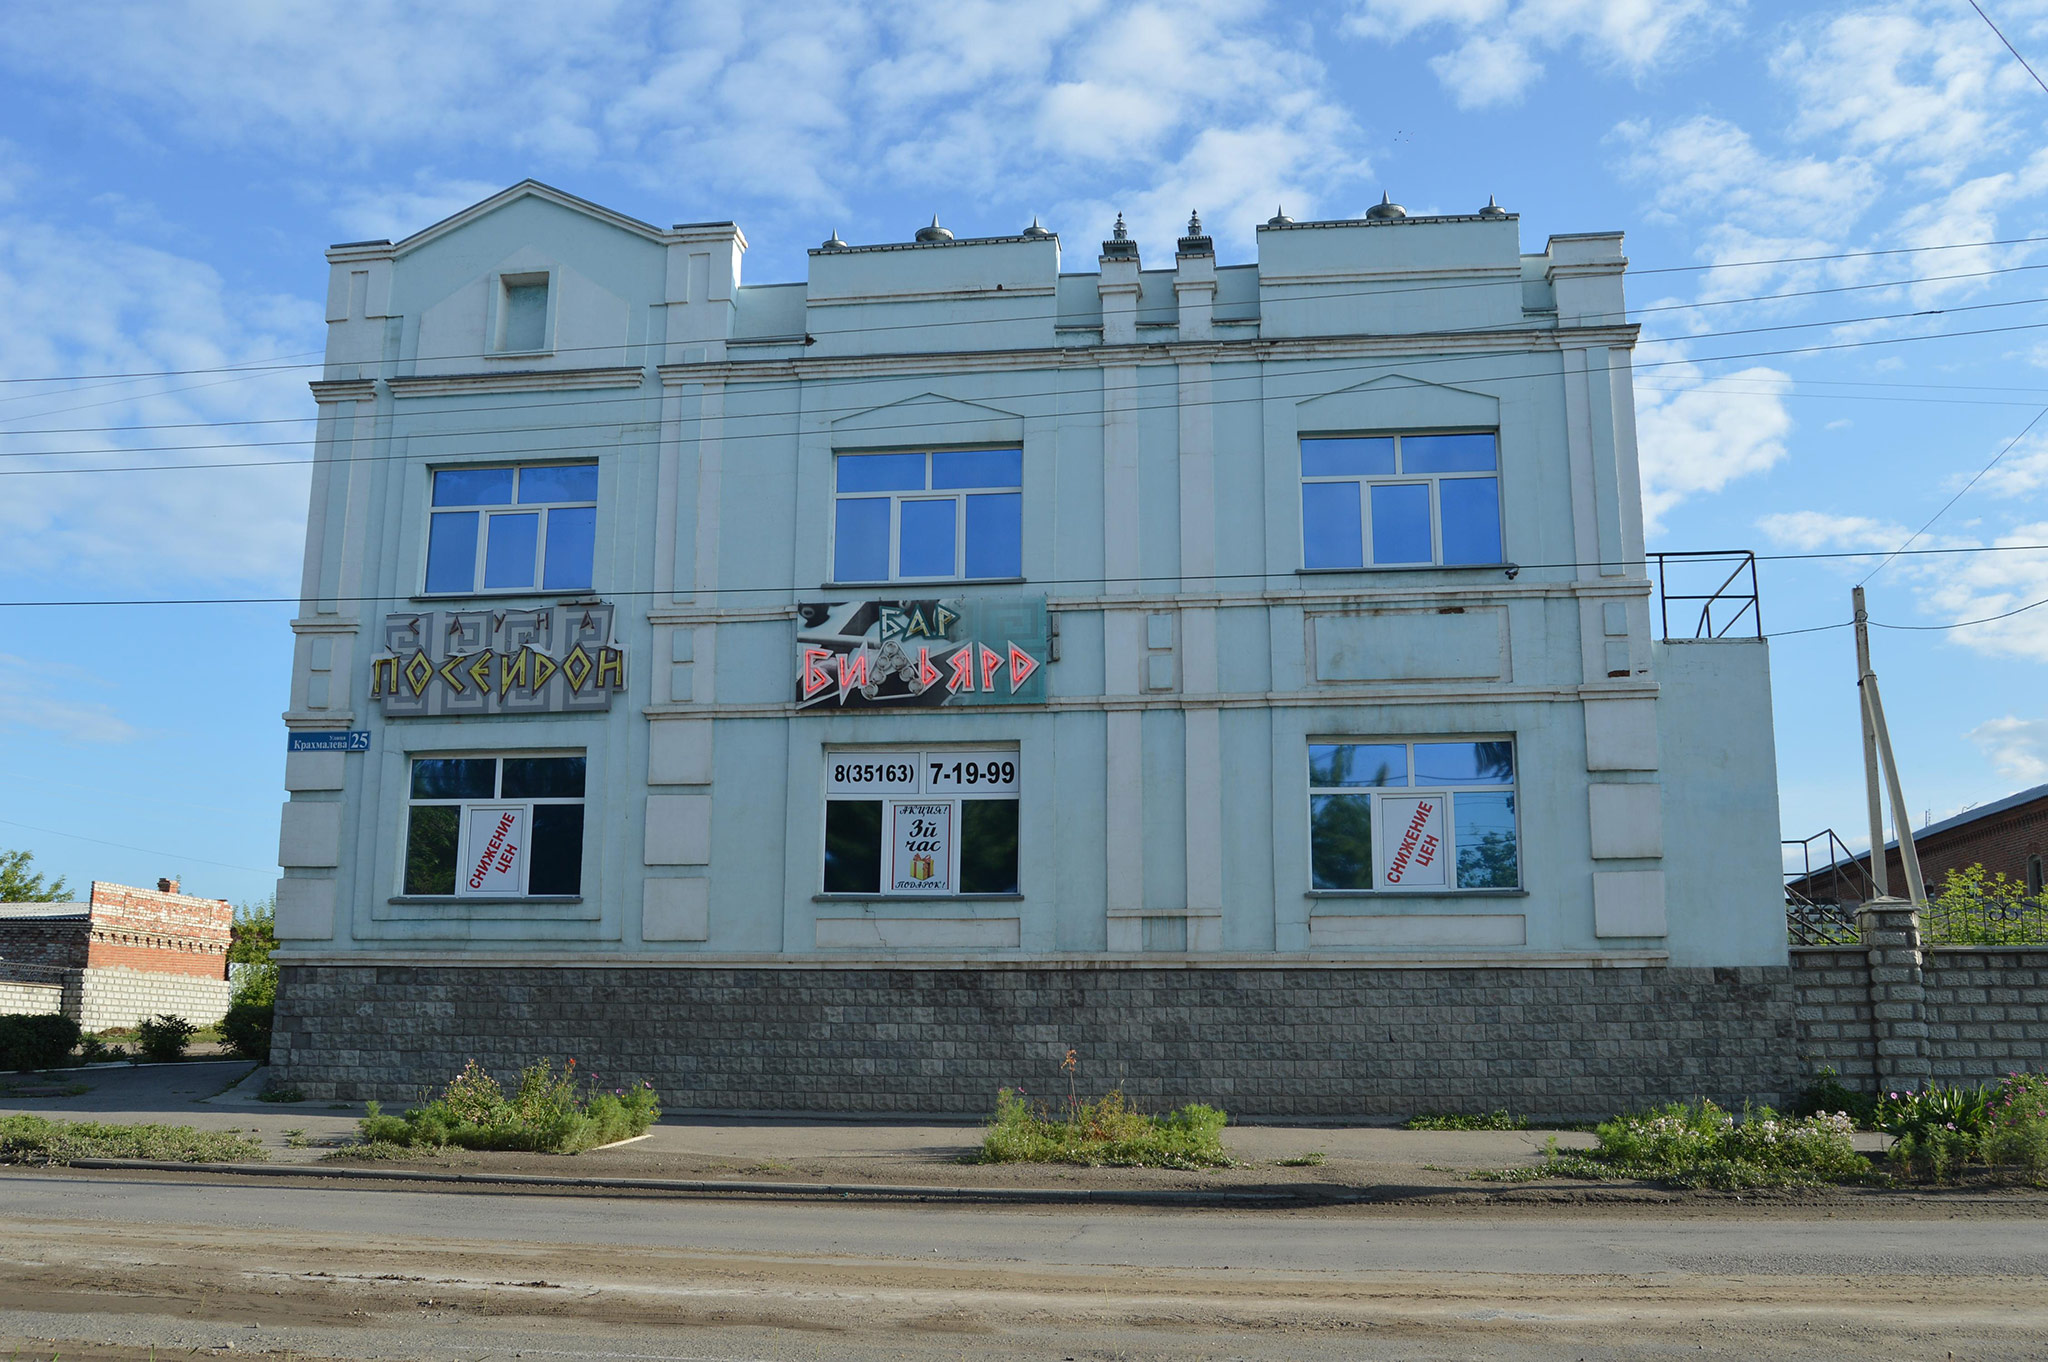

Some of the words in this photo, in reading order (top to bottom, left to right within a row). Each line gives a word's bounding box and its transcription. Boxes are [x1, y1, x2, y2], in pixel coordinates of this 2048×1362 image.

[408, 610, 595, 636] САУНА
[879, 604, 961, 642] БАР
[294, 740, 348, 751] Крахмалева
[351, 733, 369, 748] 25
[834, 764, 914, 783] 8(35163)
[930, 762, 1015, 784] 7-19-99
[469, 812, 515, 889] СНИЖЕНИЕ
[905, 840, 942, 852] час
[1387, 801, 1433, 883] СНИЖЕНИЕ
[1415, 834, 1439, 867] ЦЕН
[495, 843, 518, 874] ЦЕН
